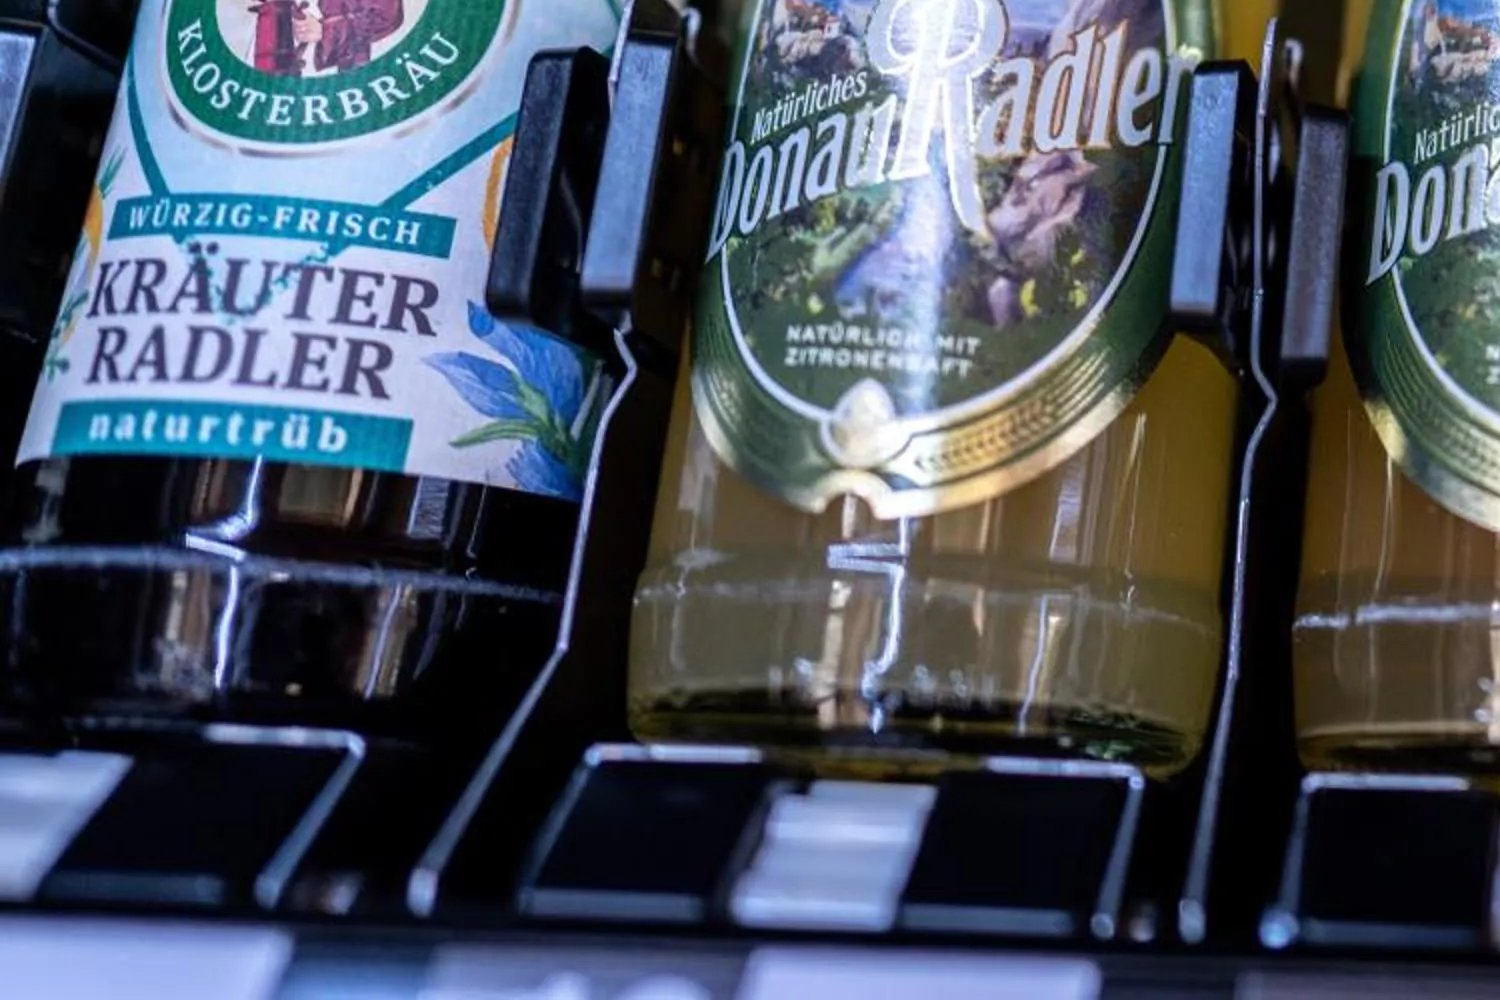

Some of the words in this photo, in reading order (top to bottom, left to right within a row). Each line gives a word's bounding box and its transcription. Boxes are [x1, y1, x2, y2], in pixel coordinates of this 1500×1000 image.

[176, 19, 463, 127] KLOSTERBRÄU
[751, 69, 868, 145] Natürliches
[128, 198, 423, 246] WÜRZIG-FRISCH
[87, 239, 440, 337] KRÄUTER
[84, 325, 395, 400] RADLER
[936, 334, 982, 356] MIT
[87, 409, 349, 454] naturtrüb
